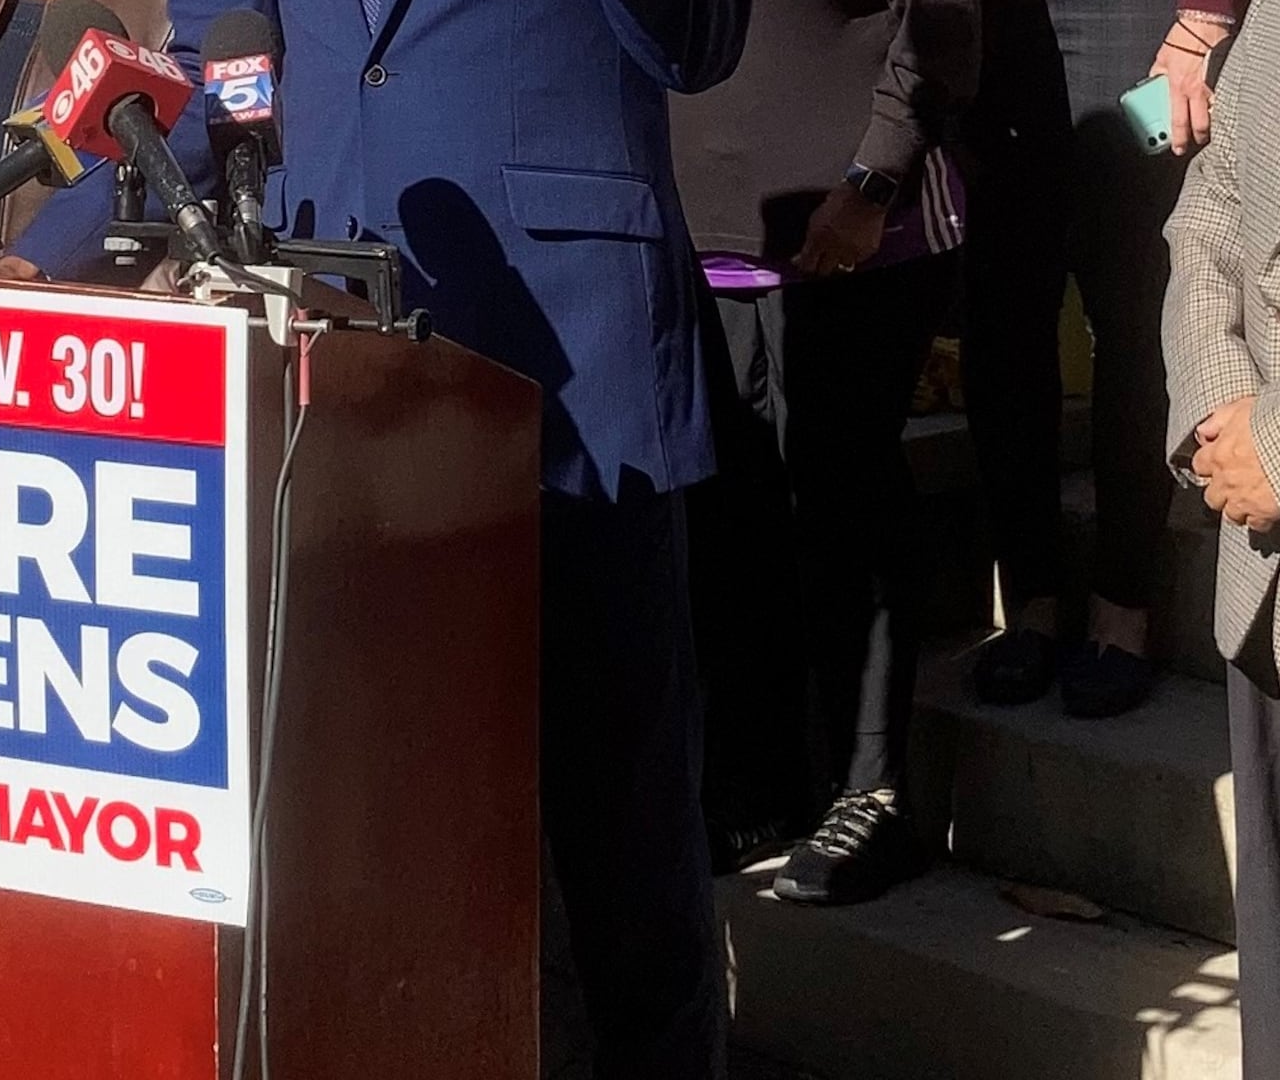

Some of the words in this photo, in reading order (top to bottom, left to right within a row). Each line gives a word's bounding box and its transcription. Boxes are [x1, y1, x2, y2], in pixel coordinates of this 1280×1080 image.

[71, 39, 105, 96] 46
[138, 46, 186, 82] 46
[212, 55, 266, 80] FOX
[219, 75, 258, 111] 5
[51, 334, 145, 419] 30!
